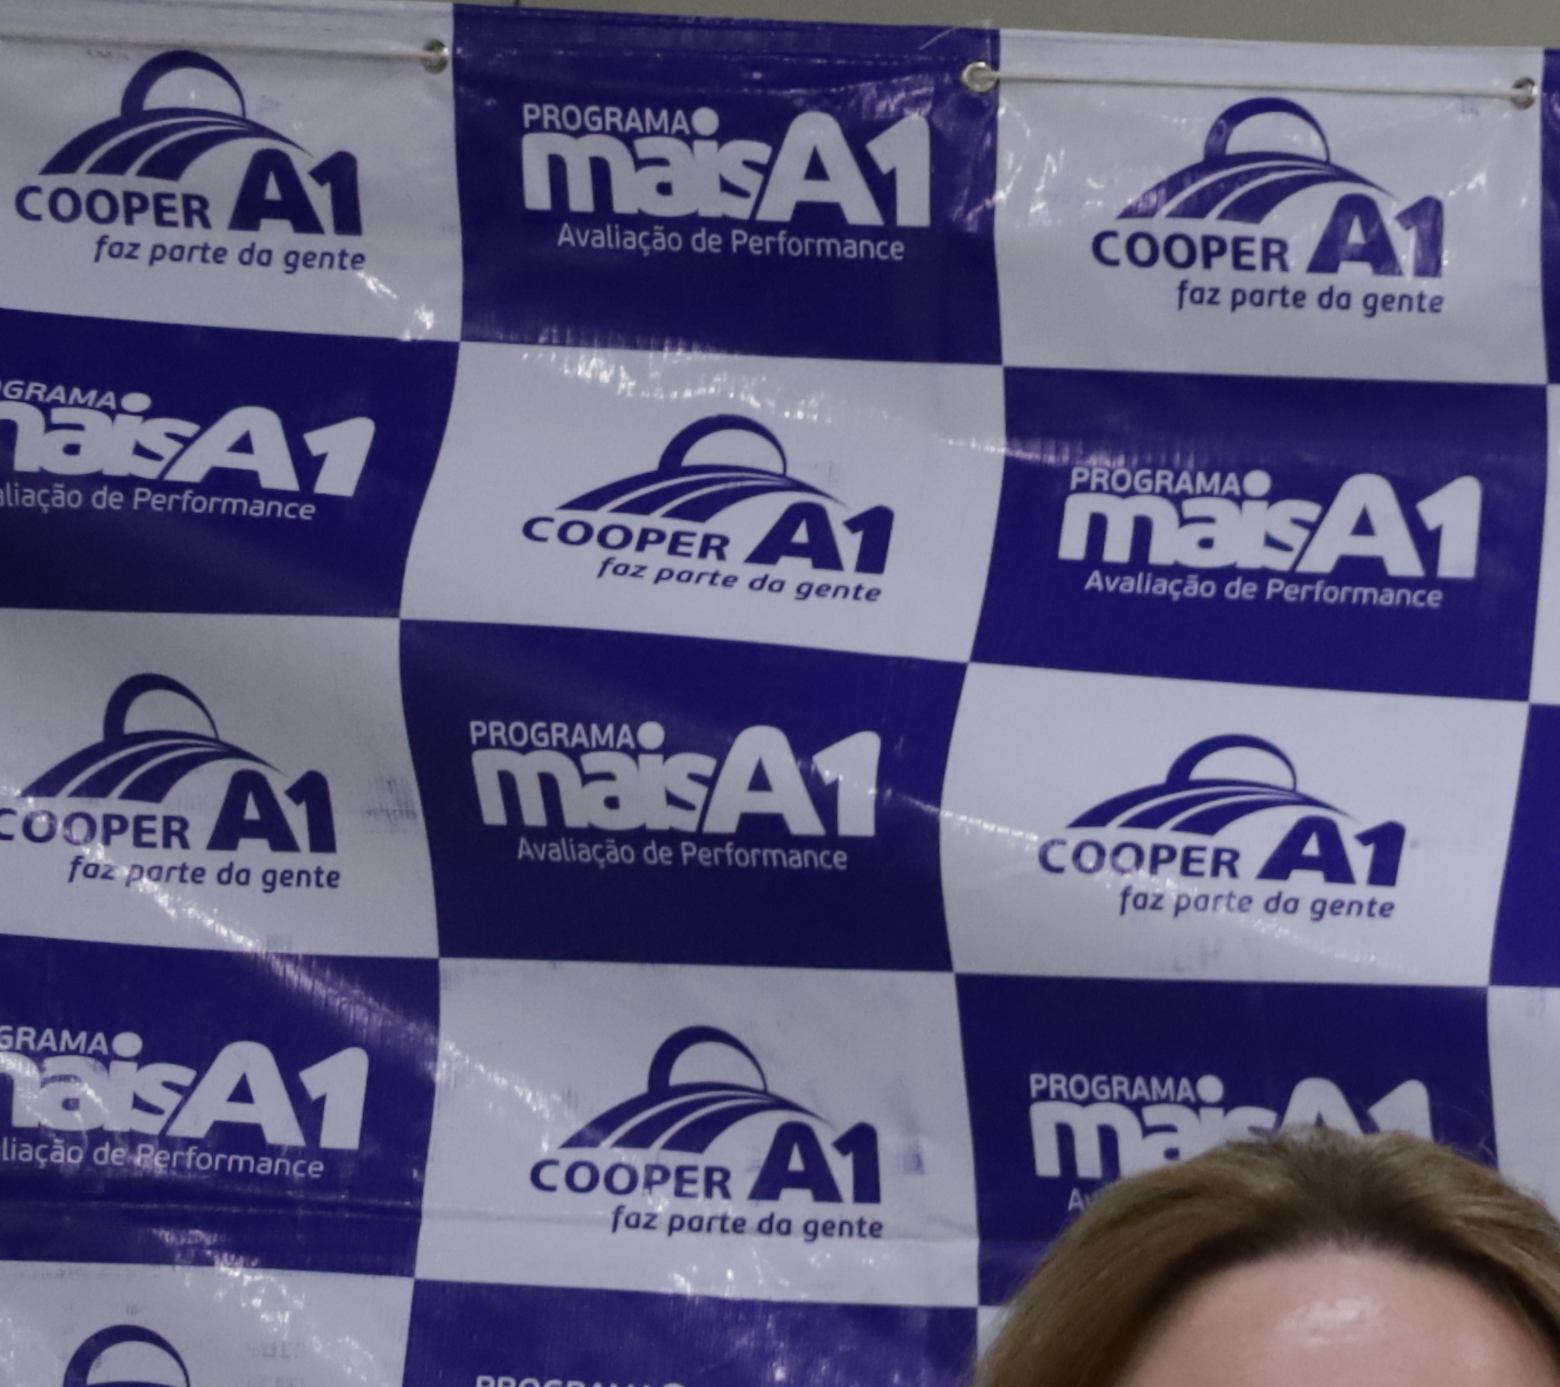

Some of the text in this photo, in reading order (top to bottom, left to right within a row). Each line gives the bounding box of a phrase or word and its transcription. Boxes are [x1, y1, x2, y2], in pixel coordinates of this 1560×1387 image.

[523, 104, 689, 135] PROGRAMA
[557, 222, 905, 262] Avaliação de Performance
[1092, 193, 1444, 278] COOPER A1
[1175, 280, 1444, 318] faz parte da gente
